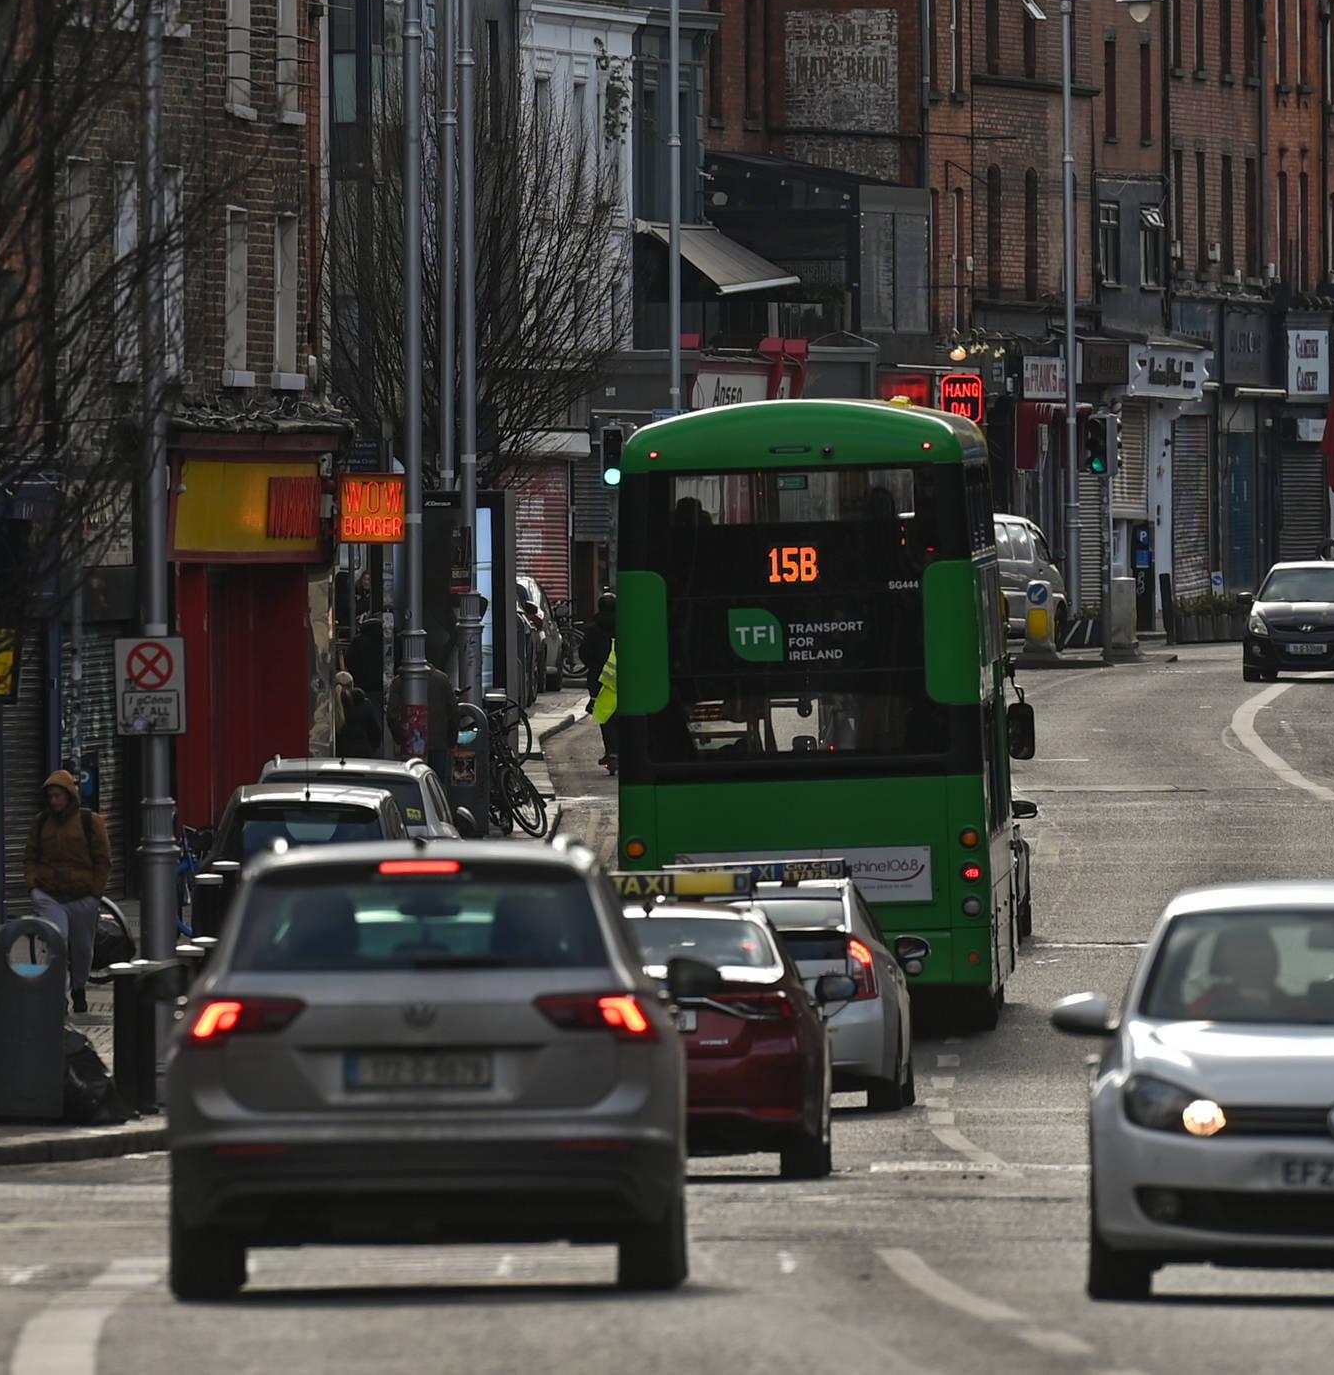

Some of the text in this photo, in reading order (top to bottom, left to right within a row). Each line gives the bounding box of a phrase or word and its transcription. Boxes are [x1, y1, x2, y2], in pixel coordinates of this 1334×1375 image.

[945, 384, 979, 398] HANG
[345, 481, 403, 514] WOW
[343, 516, 402, 537] BURGER
[1138, 530, 1149, 544] P
[768, 546, 818, 583] 15B
[887, 580, 919, 590] SG444
[788, 620, 864, 635] TRANSPORT
[735, 625, 776, 646] TFI
[788, 637, 815, 648] FOR
[788, 649, 844, 662] IRELAND
[756, 866, 777, 881] XI
[851, 859, 919, 873] shine106.8
[612, 876, 670, 895] TAXI
